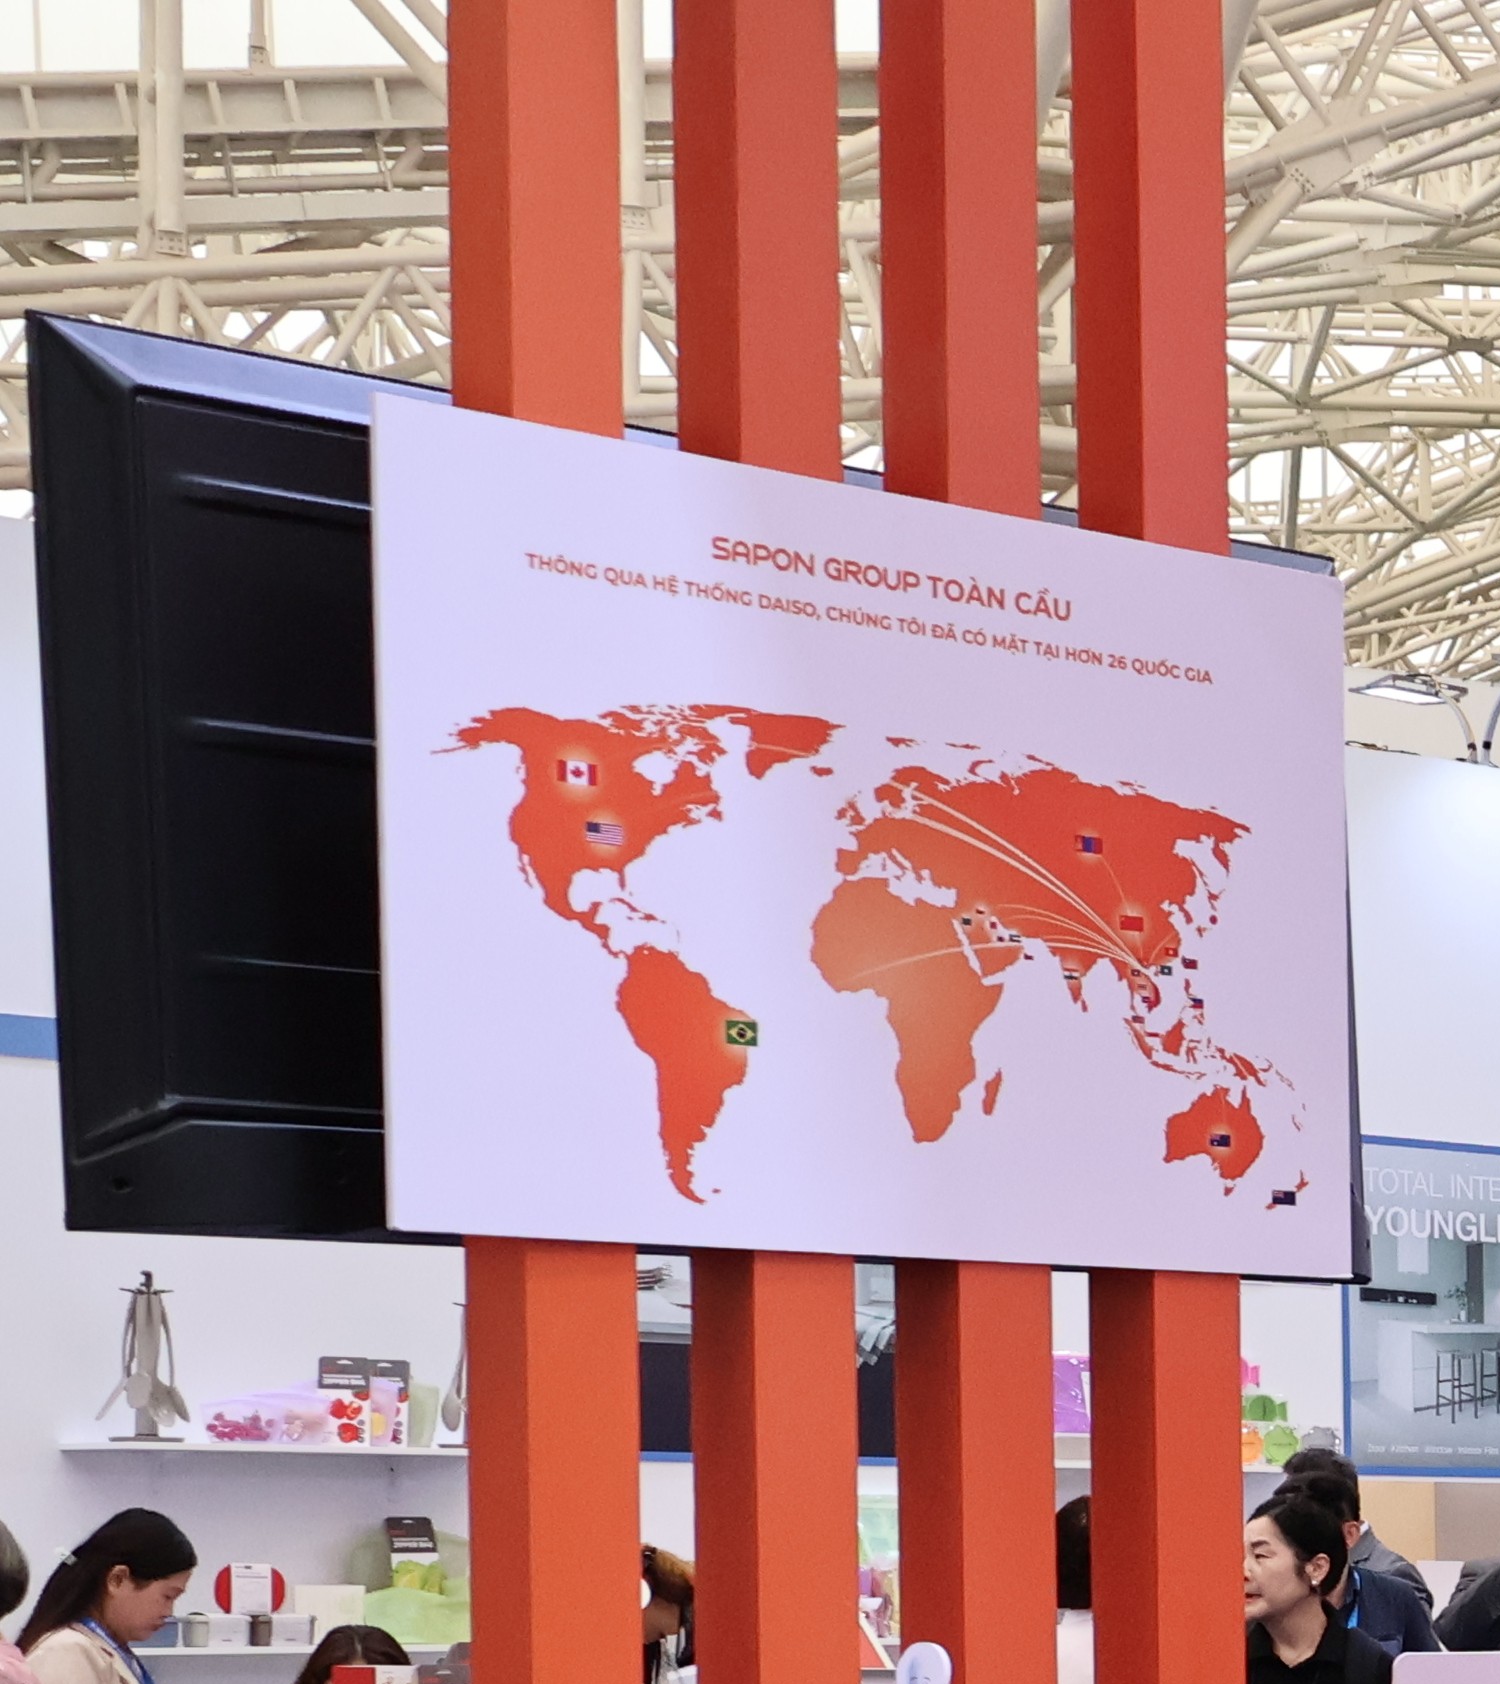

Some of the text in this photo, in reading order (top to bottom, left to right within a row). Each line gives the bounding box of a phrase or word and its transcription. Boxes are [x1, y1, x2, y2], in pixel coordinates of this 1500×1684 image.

[524, 551, 1214, 685] THÔNG QUA HỆ THỐNG DAISO, CHÚNG TÔI ĐÃ CÓ MẶT TẠI HƠN 26 QUỐC GIA
[711, 535, 1072, 622] SAPON GROUP TOÀN CẦU
[1363, 1166, 1444, 1199] TOTAL
